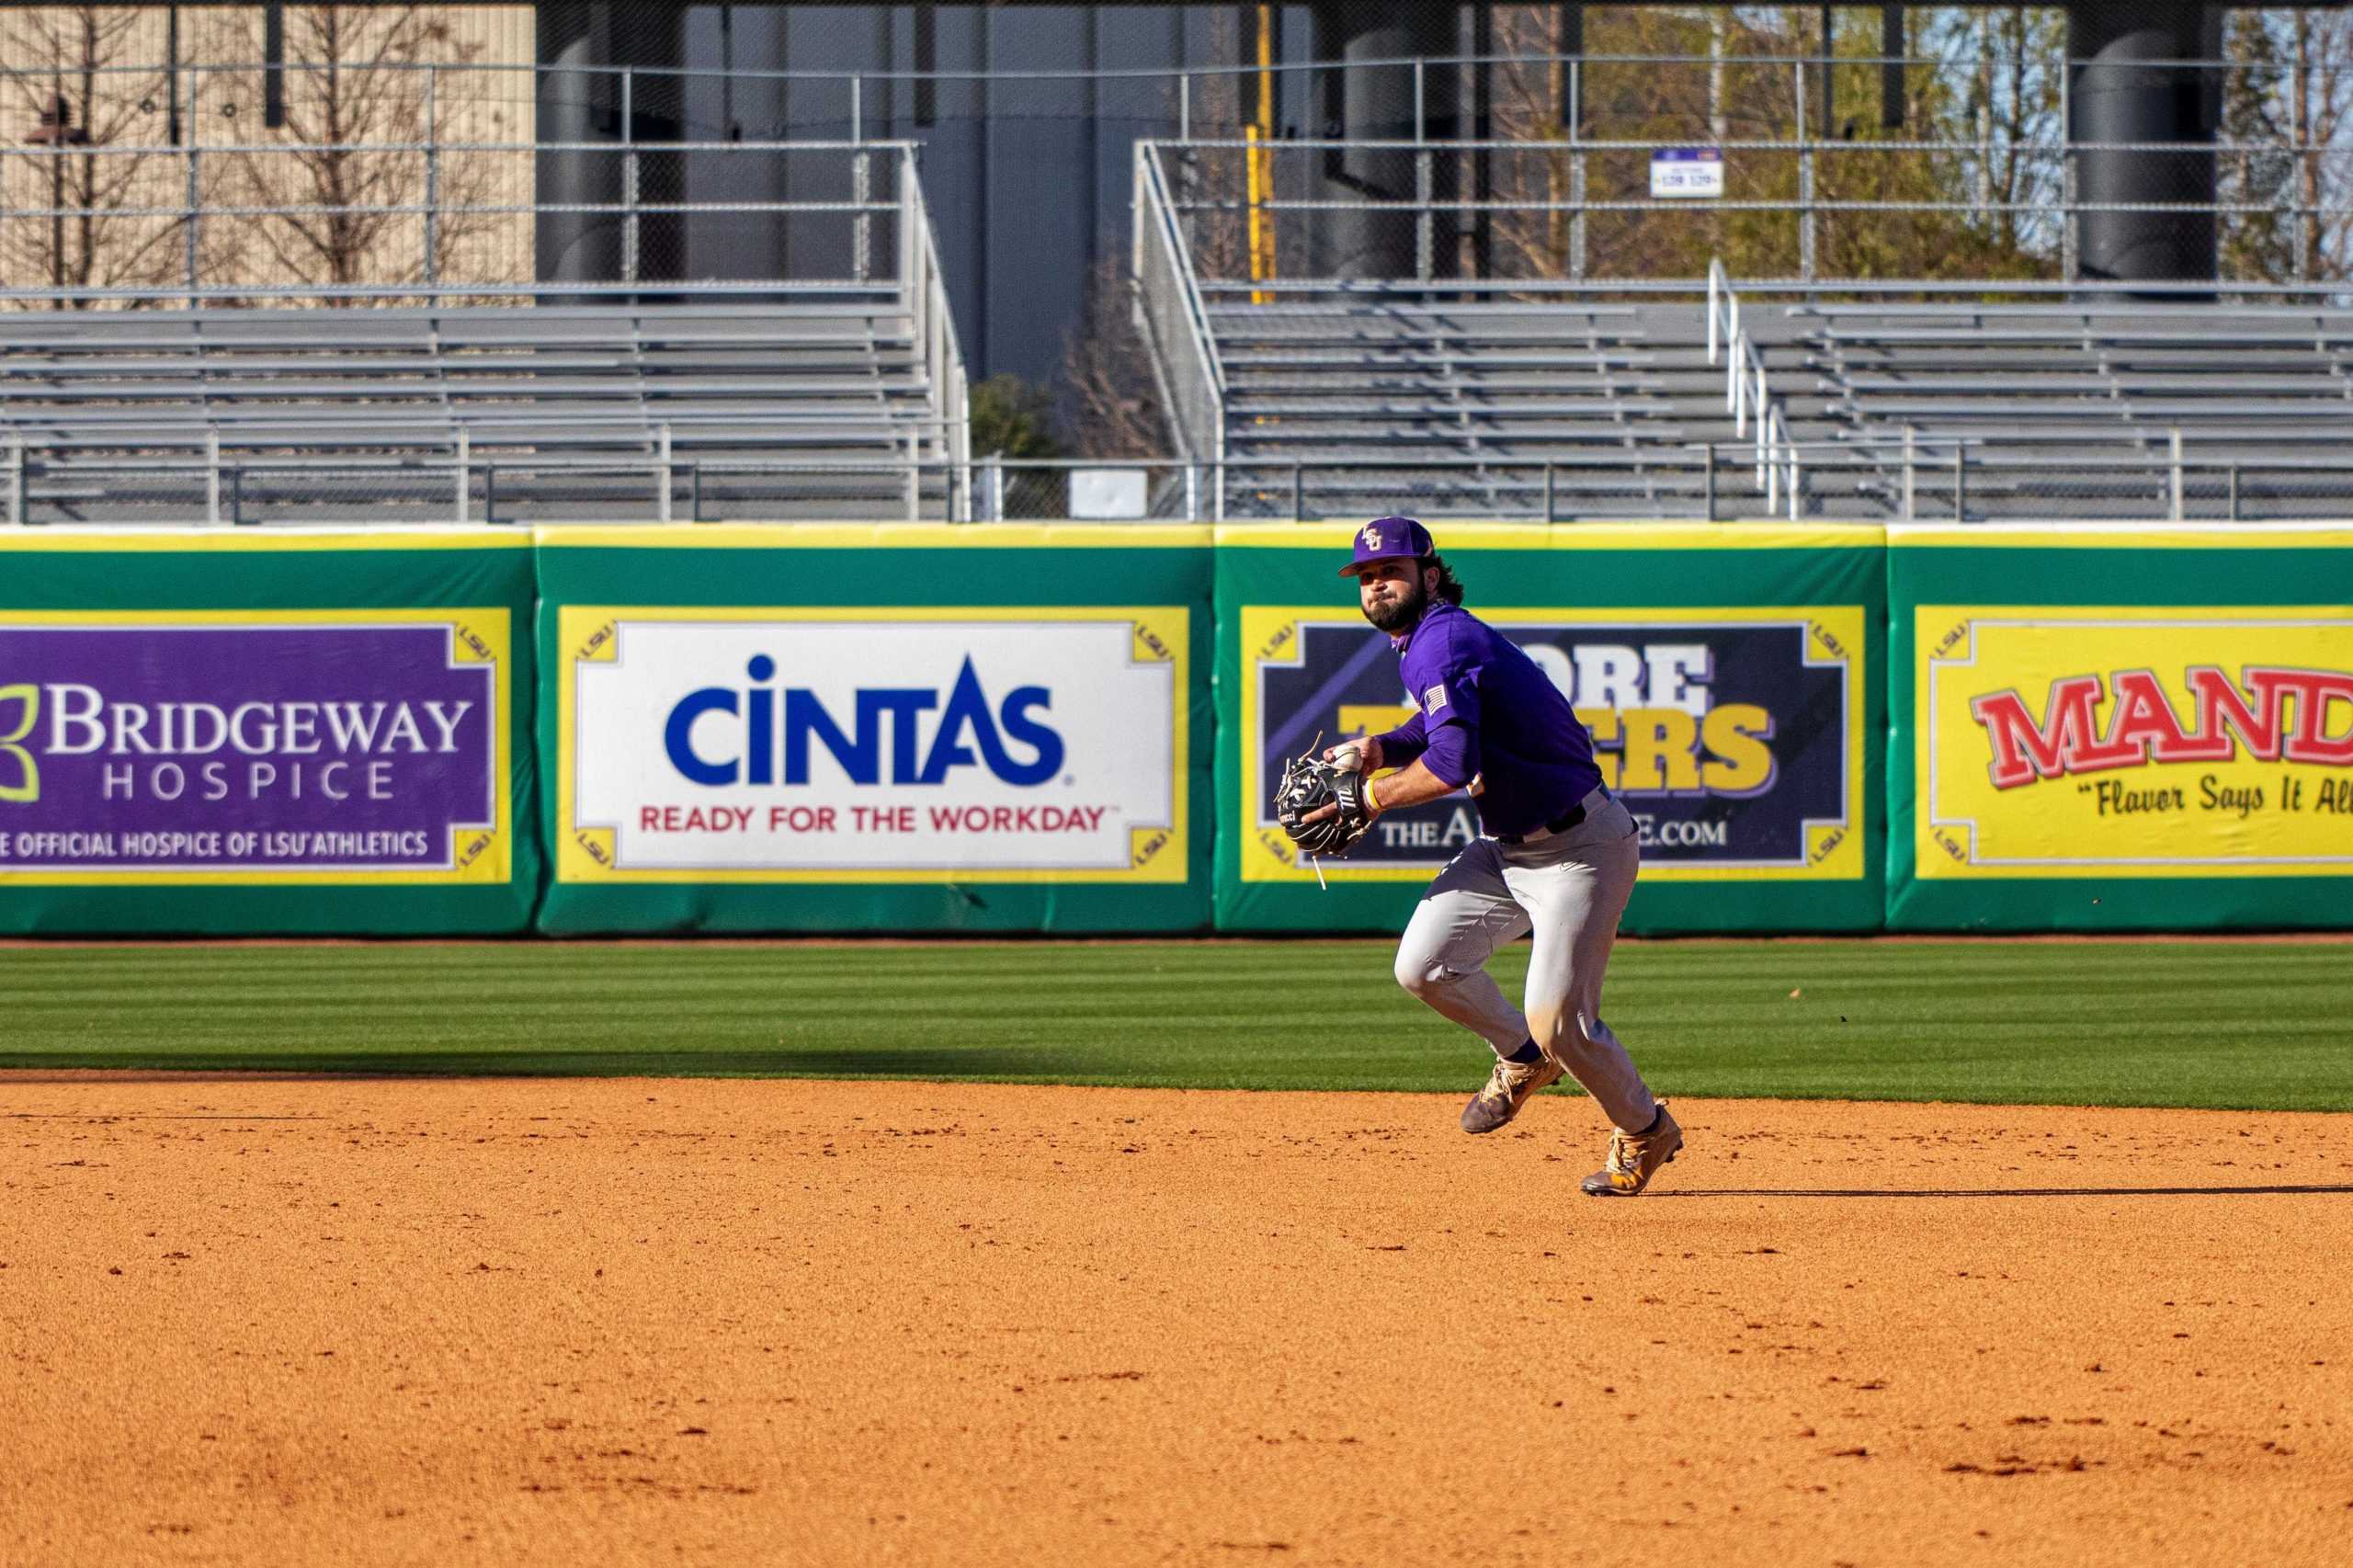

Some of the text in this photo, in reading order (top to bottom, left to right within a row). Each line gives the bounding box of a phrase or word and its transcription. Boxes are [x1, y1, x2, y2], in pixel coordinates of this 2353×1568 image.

[1361, 525, 1382, 552] LSU
[44, 683, 473, 755] BRIDGEWAY
[103, 761, 394, 801] HOSPICE
[2200, 773, 2264, 820] Says
[2280, 774, 2302, 811] It
[640, 804, 1107, 833] READY FOR THE WORKDAY
[15, 831, 119, 858] OFFICIAL
[121, 831, 222, 858] HOSPICE
[225, 831, 258, 858] OF
[312, 831, 428, 857] ATHLETICS
